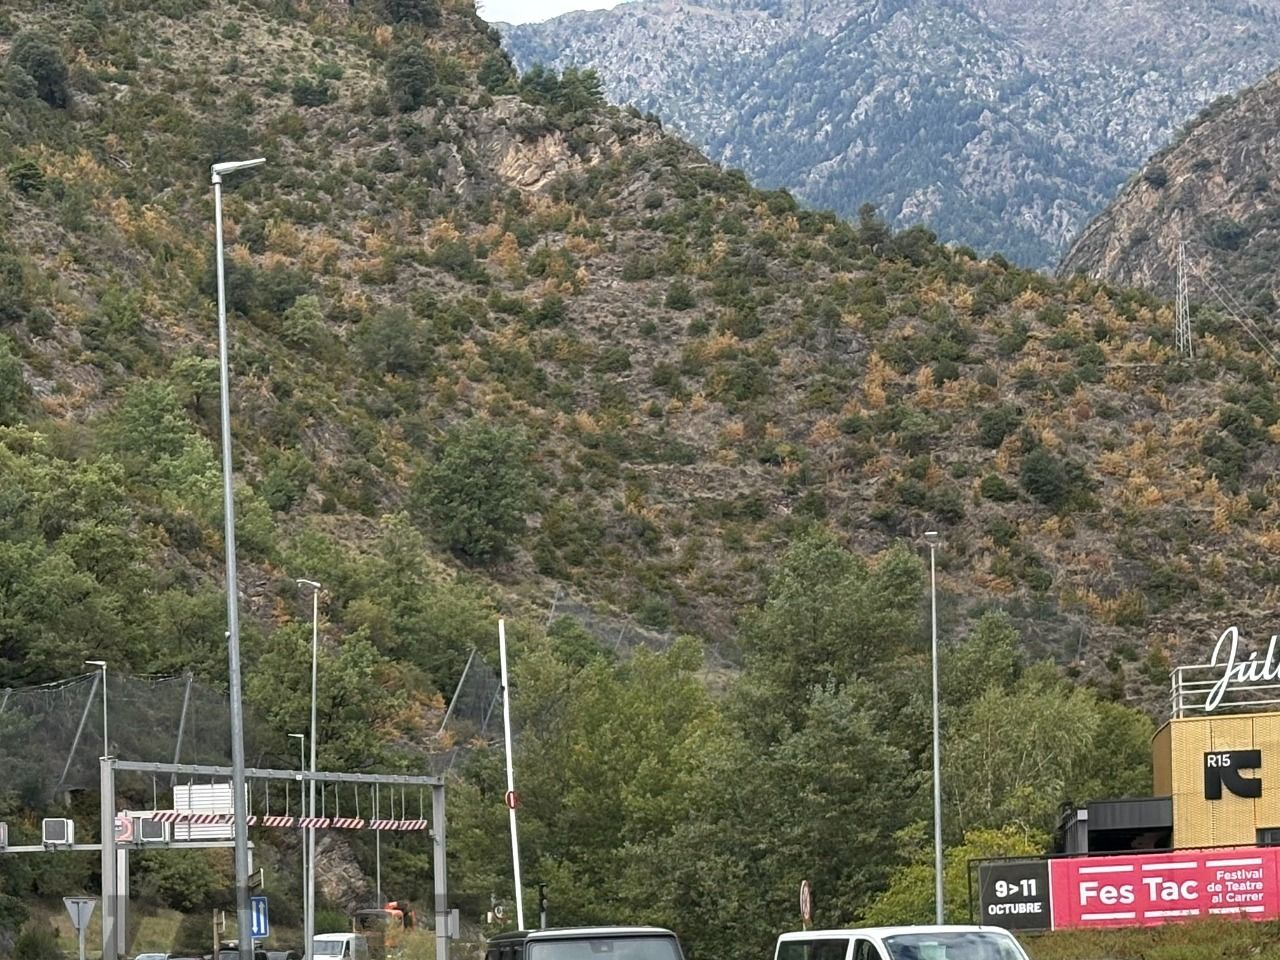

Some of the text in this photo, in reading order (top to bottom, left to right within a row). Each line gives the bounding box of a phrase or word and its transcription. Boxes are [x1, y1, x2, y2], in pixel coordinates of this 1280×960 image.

[1205, 626, 1280, 711] Júl
[1207, 754, 1231, 767] R15
[1216, 868, 1263, 881] Festival
[995, 879, 1037, 898] 9>11
[1079, 877, 1199, 906] Fes Tac
[1207, 880, 1263, 892] de Teatre
[1212, 892, 1264, 904] al Carrer
[988, 902, 1042, 915] OCTUBRE
